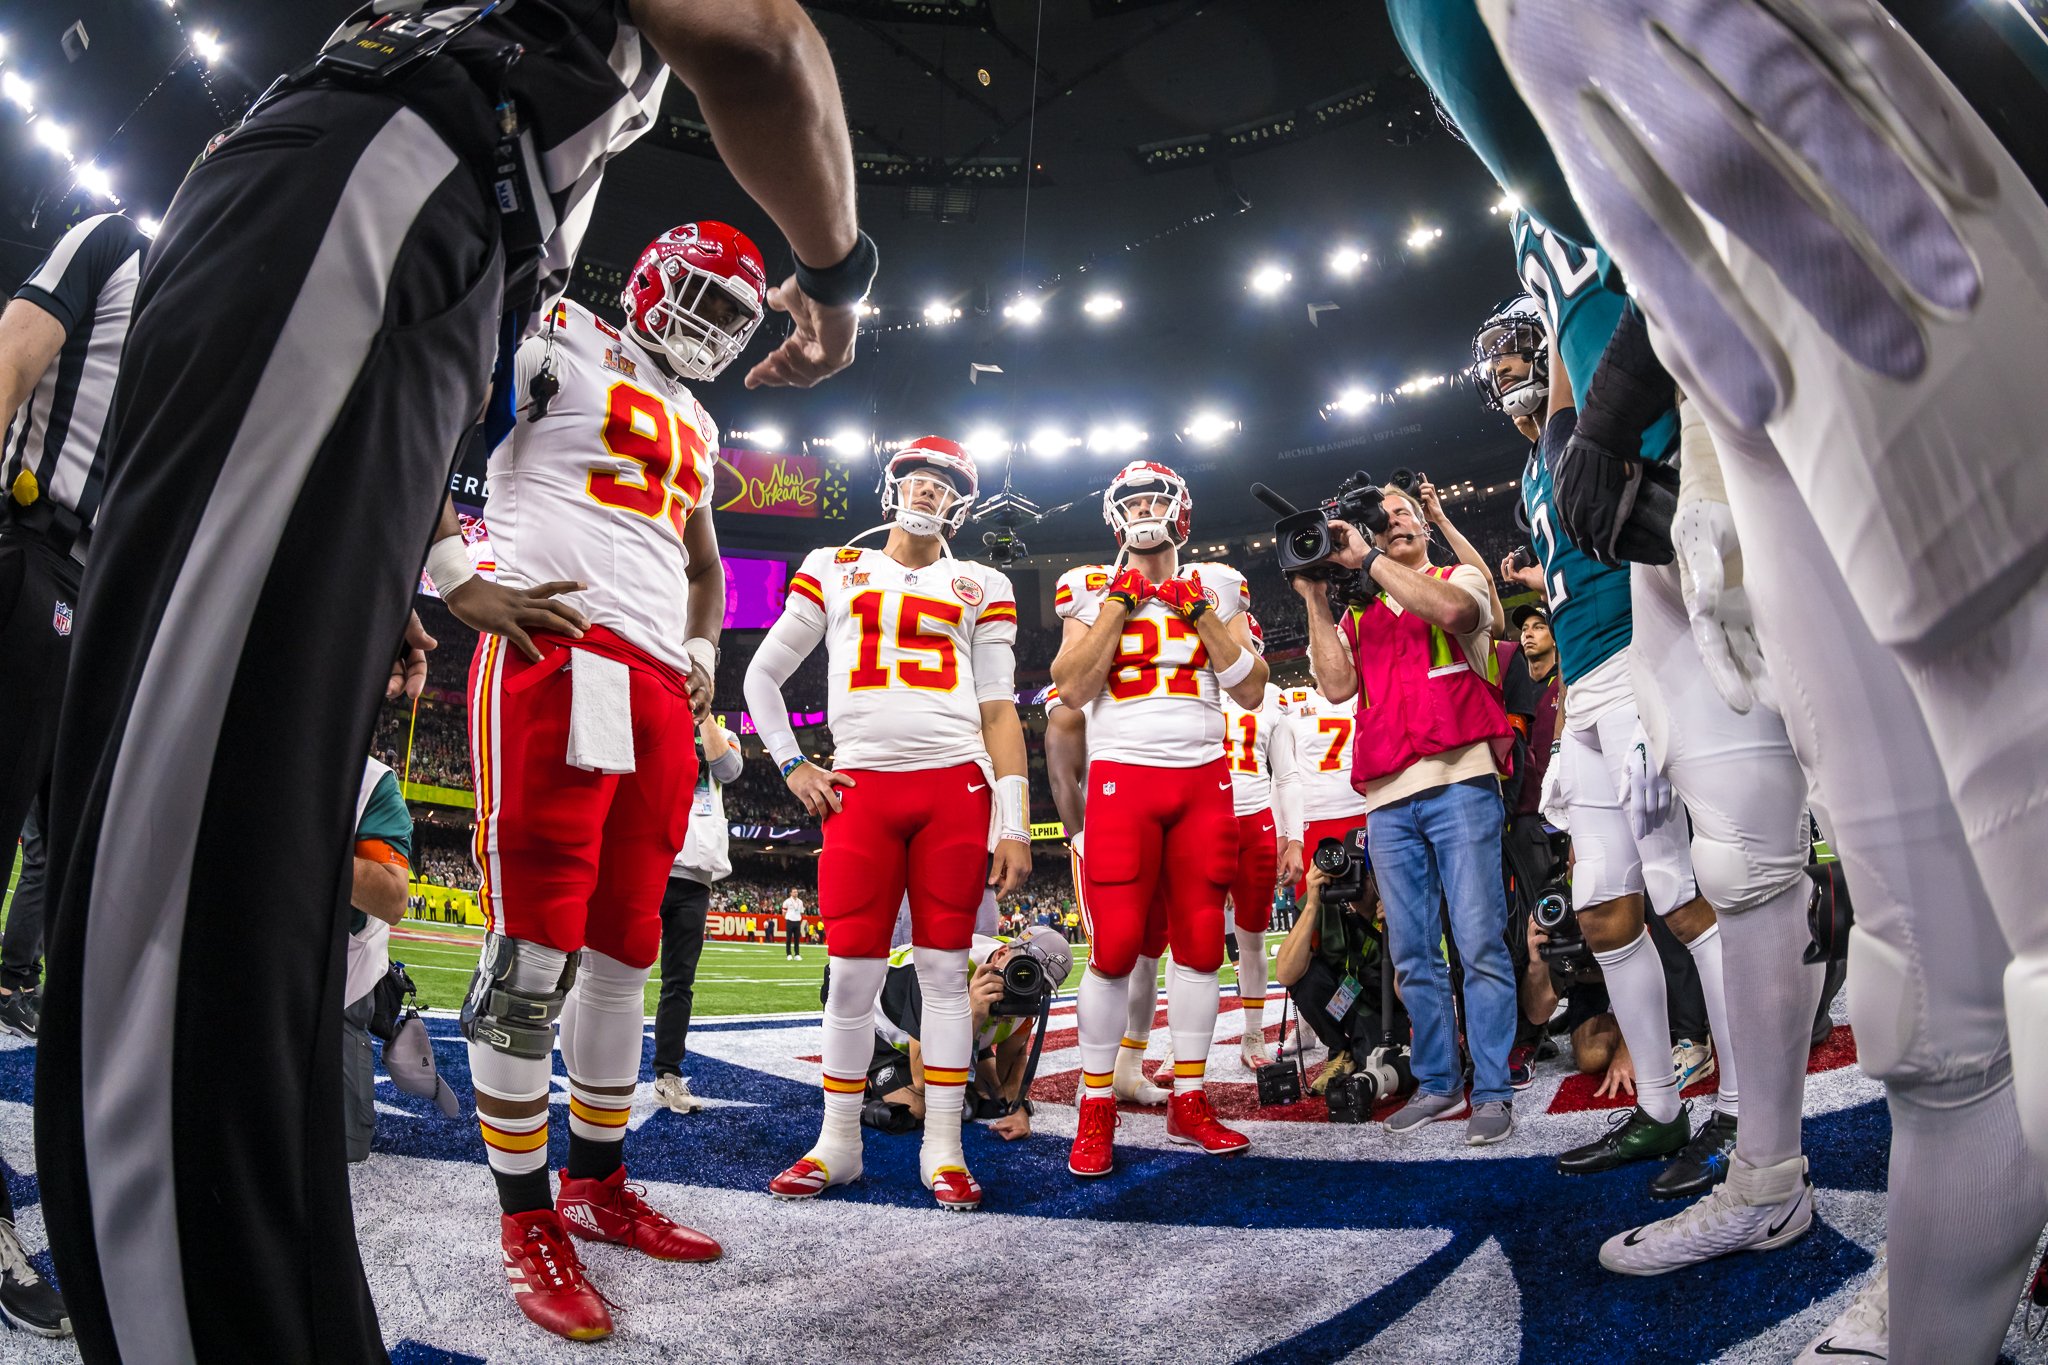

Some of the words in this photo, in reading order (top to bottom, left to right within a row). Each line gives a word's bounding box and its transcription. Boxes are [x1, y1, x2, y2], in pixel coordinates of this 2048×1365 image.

[356, 40, 379, 50] REF
[496, 183, 512, 209] ATK
[586, 380, 708, 543] 95
[1277, 445, 1315, 461] ARCHIE
[1316, 435, 1368, 455] MANNING
[766, 459, 804, 491] New
[848, 589, 964, 693] 15
[1107, 616, 1210, 702] 87
[1317, 717, 1352, 772] 7
[562, 1206, 606, 1236] adidas
